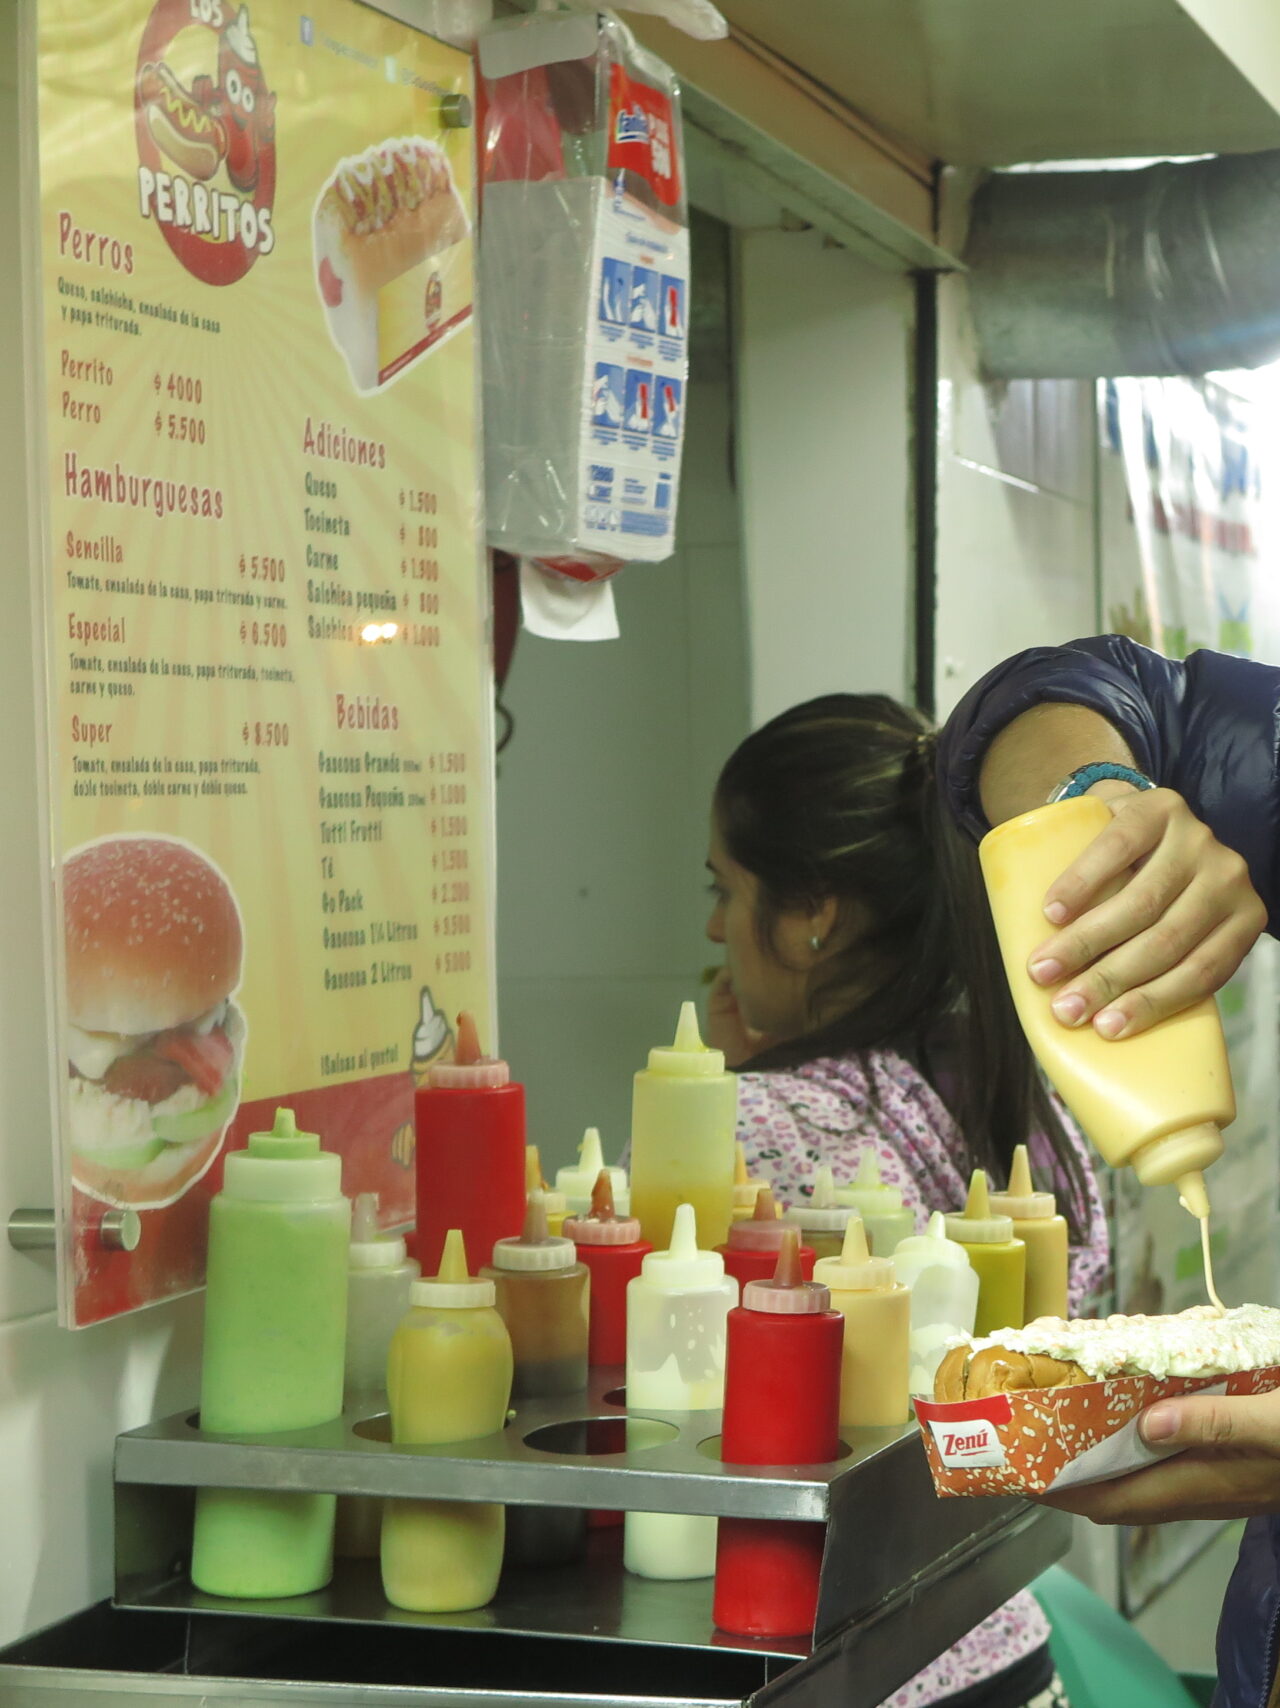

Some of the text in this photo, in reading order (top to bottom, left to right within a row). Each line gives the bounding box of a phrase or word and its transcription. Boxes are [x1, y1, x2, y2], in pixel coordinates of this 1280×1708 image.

[139, 167, 275, 254] PERRITOS
[59, 213, 133, 274] Perros
[70, 307, 92, 327] papa
[61, 350, 113, 386] Perrito
[167, 373, 202, 404] 4000
[62, 391, 100, 424] Perro
[168, 414, 205, 445] 5.500
[304, 417, 385, 469] Adiciones
[65, 452, 223, 519] Hamburguesas
[305, 472, 337, 500] Queso
[304, 508, 350, 536] Tocineta
[67, 531, 123, 563] Sencilla
[251, 556, 285, 583] 5.500
[306, 544, 339, 571] Carne
[148, 580, 158, 596] de
[159, 581, 169, 597] la
[68, 613, 124, 646] Especial
[150, 659, 160, 675] de
[161, 659, 170, 675] la
[336, 694, 399, 730] Bebidas
[72, 715, 112, 747] Super
[153, 758, 163, 773] de
[164, 757, 173, 773] la
[319, 751, 361, 773] Gaseosa
[365, 752, 400, 773] Grande
[319, 787, 362, 809] Gaseosa
[366, 785, 405, 811] Pequeña
[321, 821, 347, 844] Tutti
[351, 820, 383, 842] Frutti
[323, 927, 365, 949] Gaseosa
[387, 920, 418, 942] Litros
[325, 968, 366, 990] Gaseosa
[371, 963, 379, 985] 2
[381, 961, 412, 984] Litros
[943, 1429, 989, 1456] Zenú
